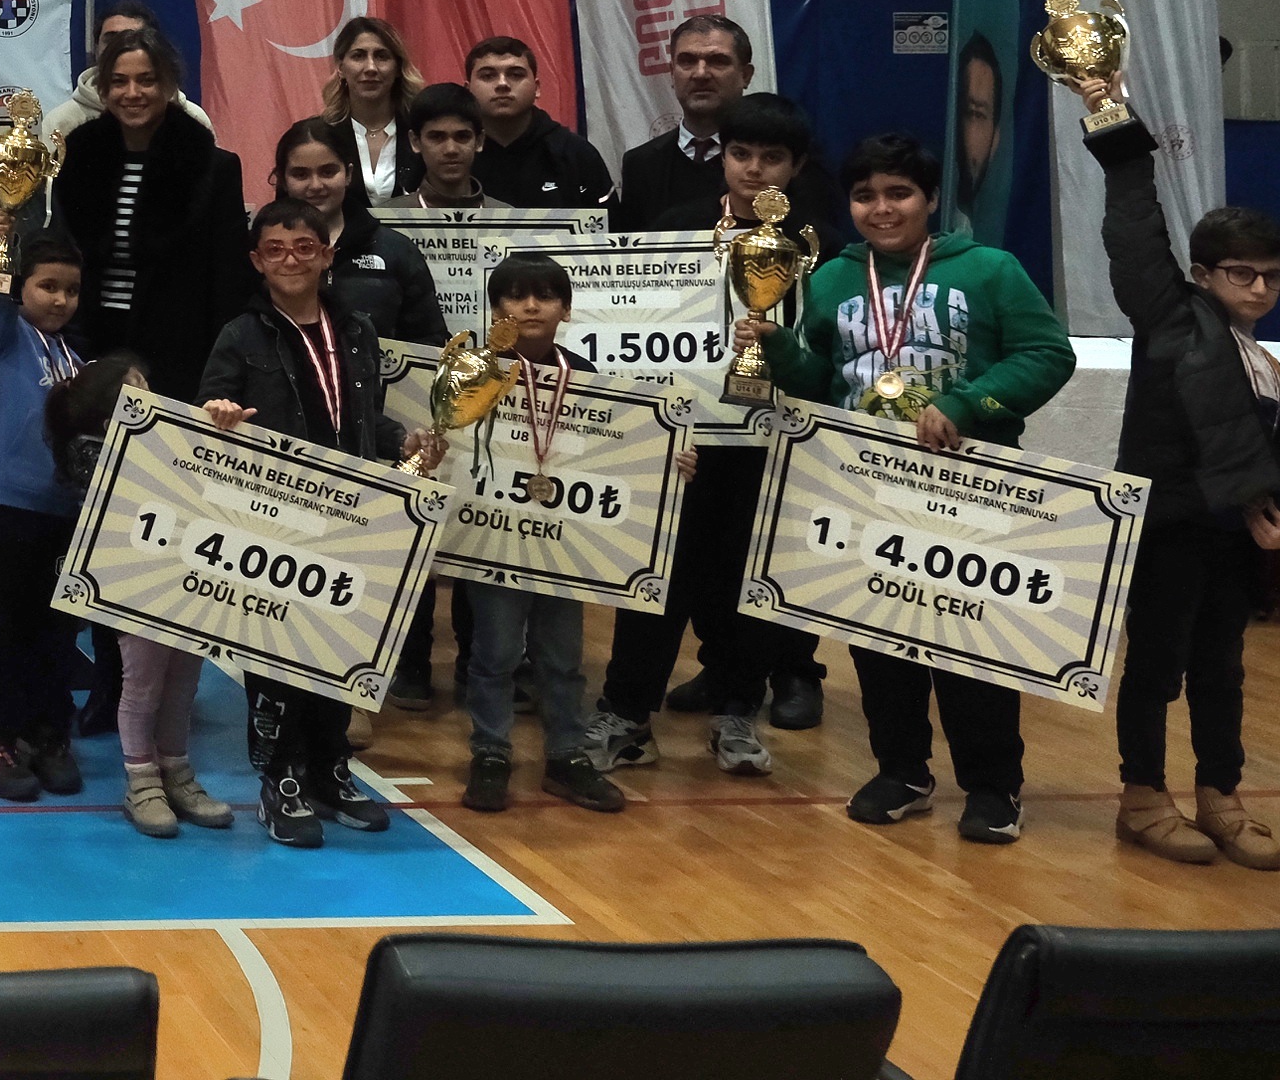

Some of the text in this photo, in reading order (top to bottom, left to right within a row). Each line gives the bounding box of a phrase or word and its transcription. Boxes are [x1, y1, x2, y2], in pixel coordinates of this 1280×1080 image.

[448, 268, 472, 277] U14
[616, 260, 701, 276] BELEDİYESİ
[611, 294, 637, 305] U14
[510, 429, 529, 442] U8
[192, 445, 361, 509] CEYHAN BELEDİYESİ
[839, 462, 846, 472] 6
[846, 464, 871, 478] OCAK
[967, 493, 1008, 512] SATRANÇ
[1009, 503, 1058, 523] TURNUVASI
[858, 449, 1045, 505] CEYHAN BELEDİYESİ
[250, 499, 279, 518] U10
[458, 503, 564, 541] ÖDÜL ÇEKİ
[926, 500, 958, 518] U14
[139, 512, 168, 547] 1.
[812, 516, 846, 550] 1.
[182, 571, 290, 623] ÖDÜL ÇEKİ
[867, 572, 985, 622] ÖDÜL ÇEKİ
